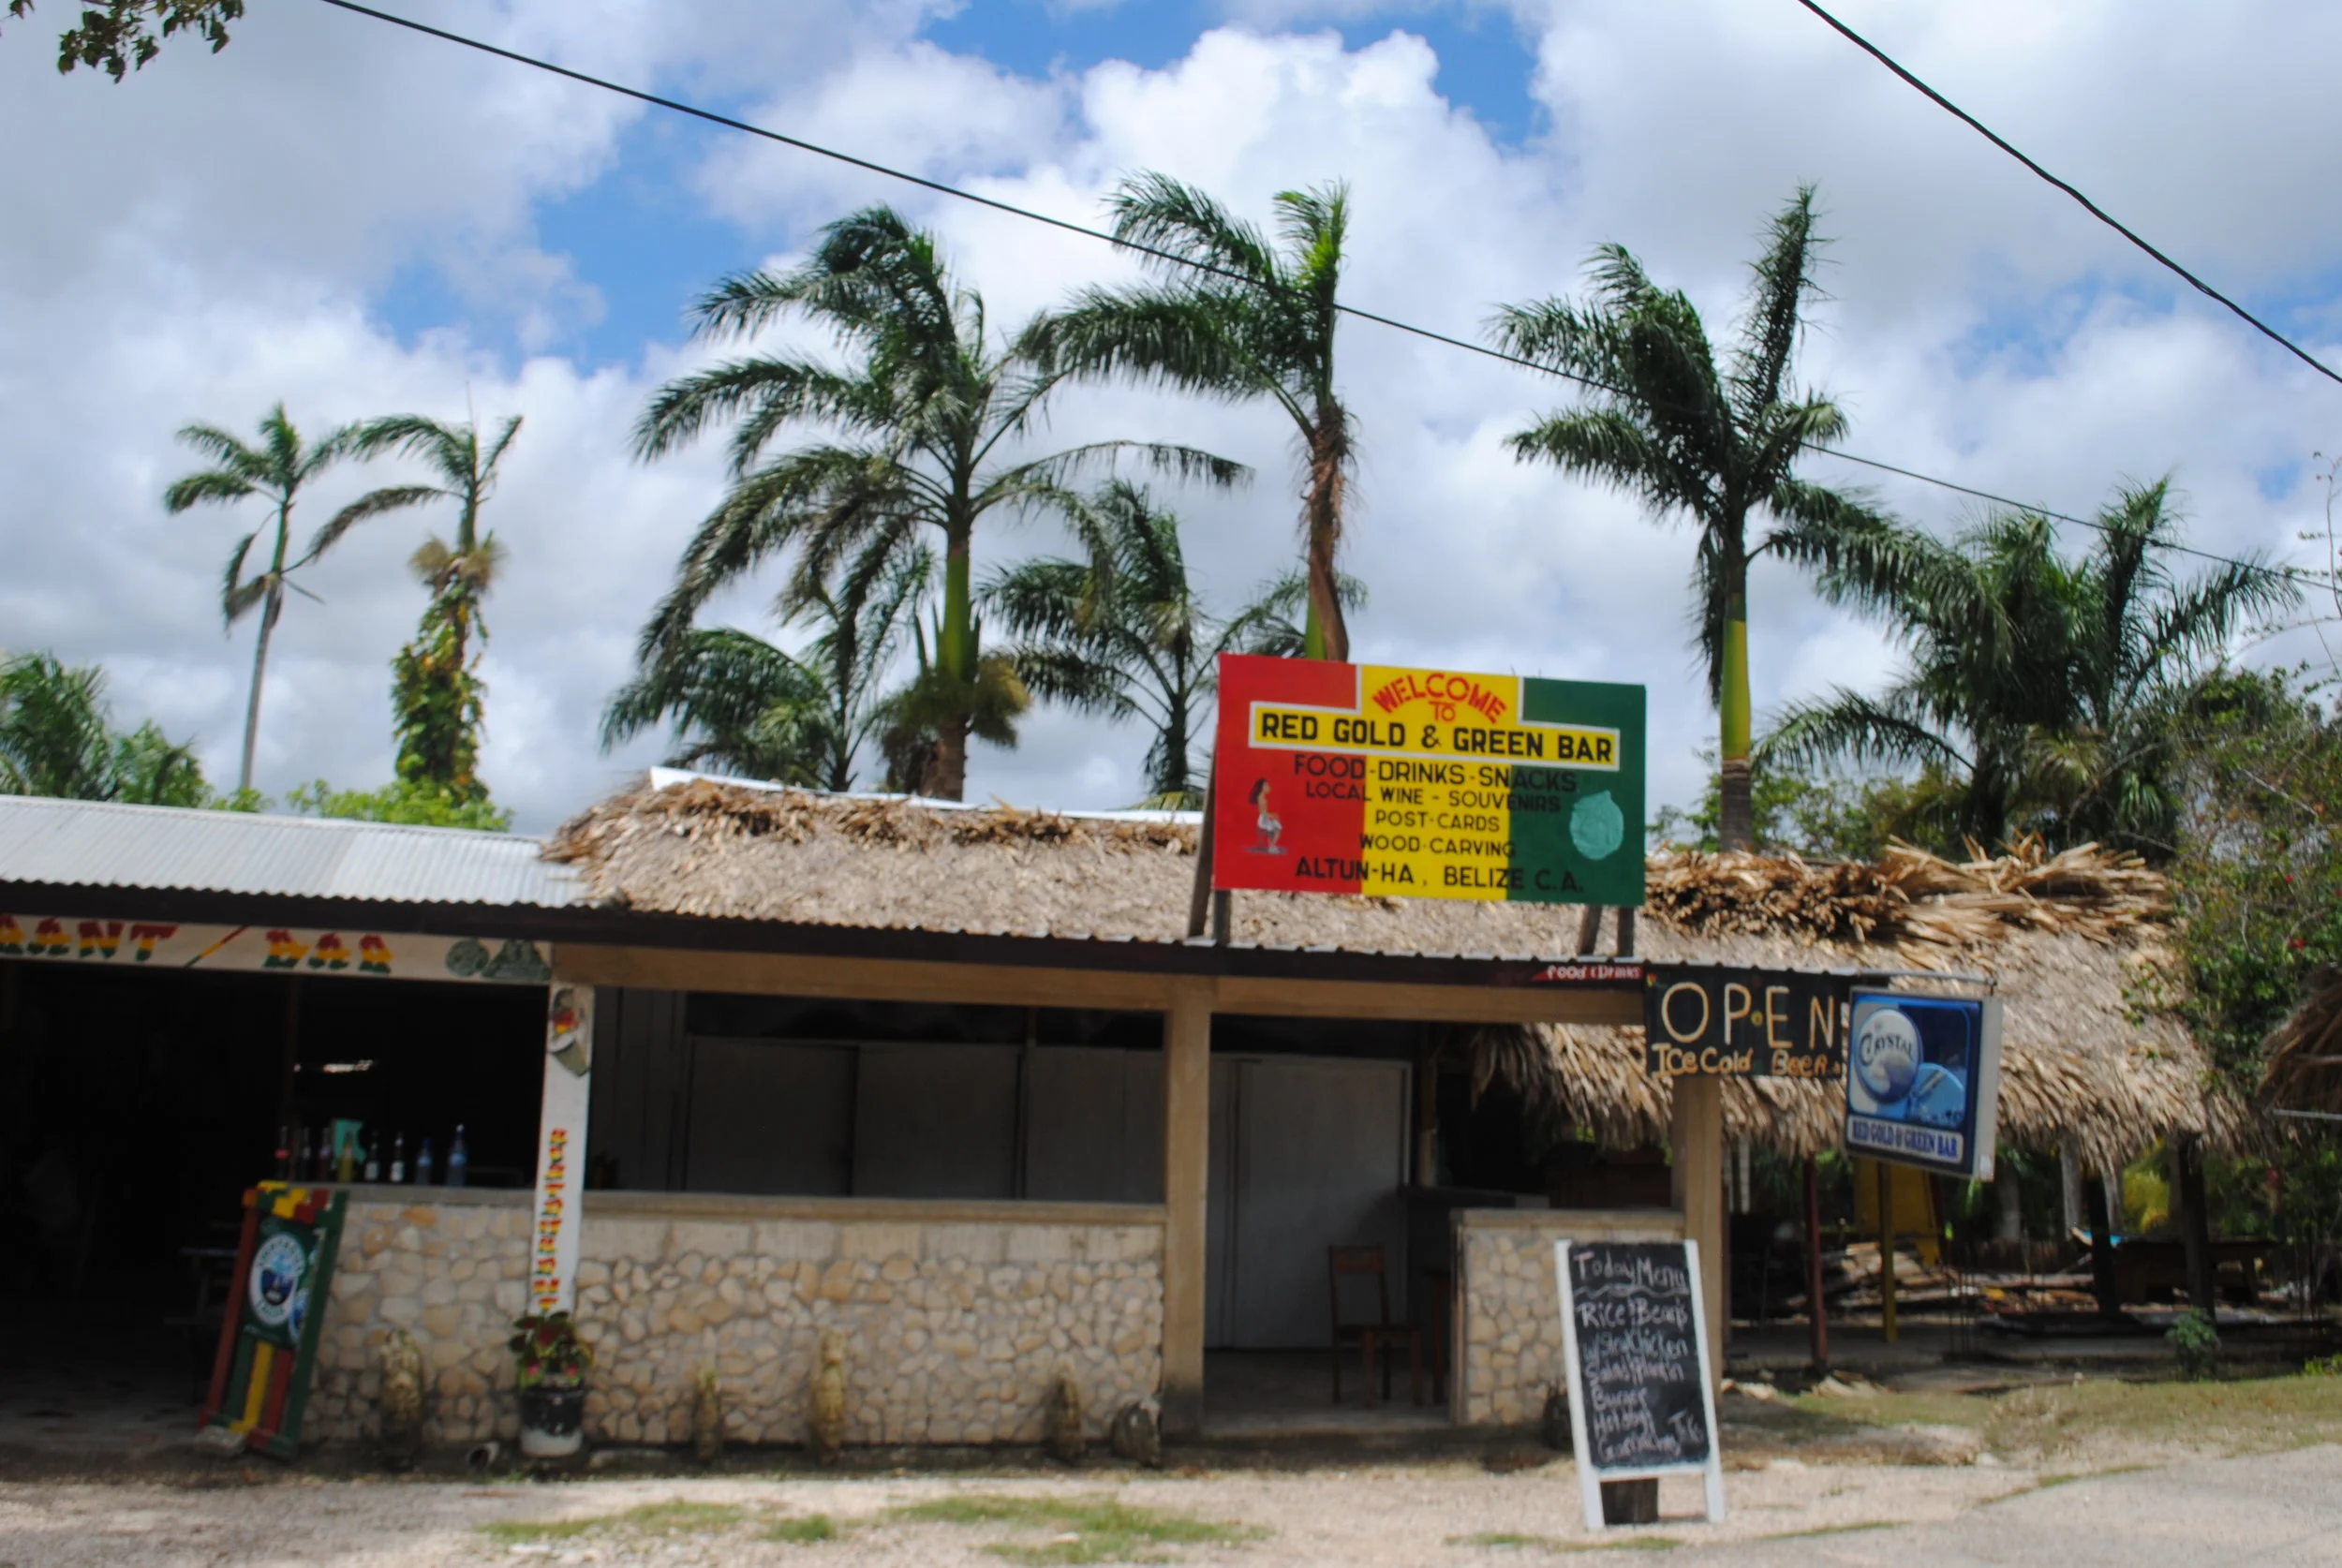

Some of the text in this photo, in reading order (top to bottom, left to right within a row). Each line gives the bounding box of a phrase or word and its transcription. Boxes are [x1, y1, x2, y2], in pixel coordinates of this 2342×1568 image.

[1371, 672, 1507, 725] WELCOME
[1429, 700, 1456, 723] TO
[1261, 712, 1612, 762] RED GOLD & GREEN BAR
[1305, 780, 1371, 802] LOCAL
[1380, 786, 1424, 805] WINE
[1448, 790, 1561, 813] SOUVENIRS
[1444, 865, 1525, 891] BELIZE
[1534, 869, 1584, 893] C.A.
[262, 928, 395, 974] BAR
[1661, 982, 1836, 1051] OPEN
[1872, 1123, 1895, 1147] GOLD
[1904, 1129, 1936, 1155] GREEN
[1936, 1134, 1958, 1159] BAR
[1575, 1301, 1626, 1328] Rice
